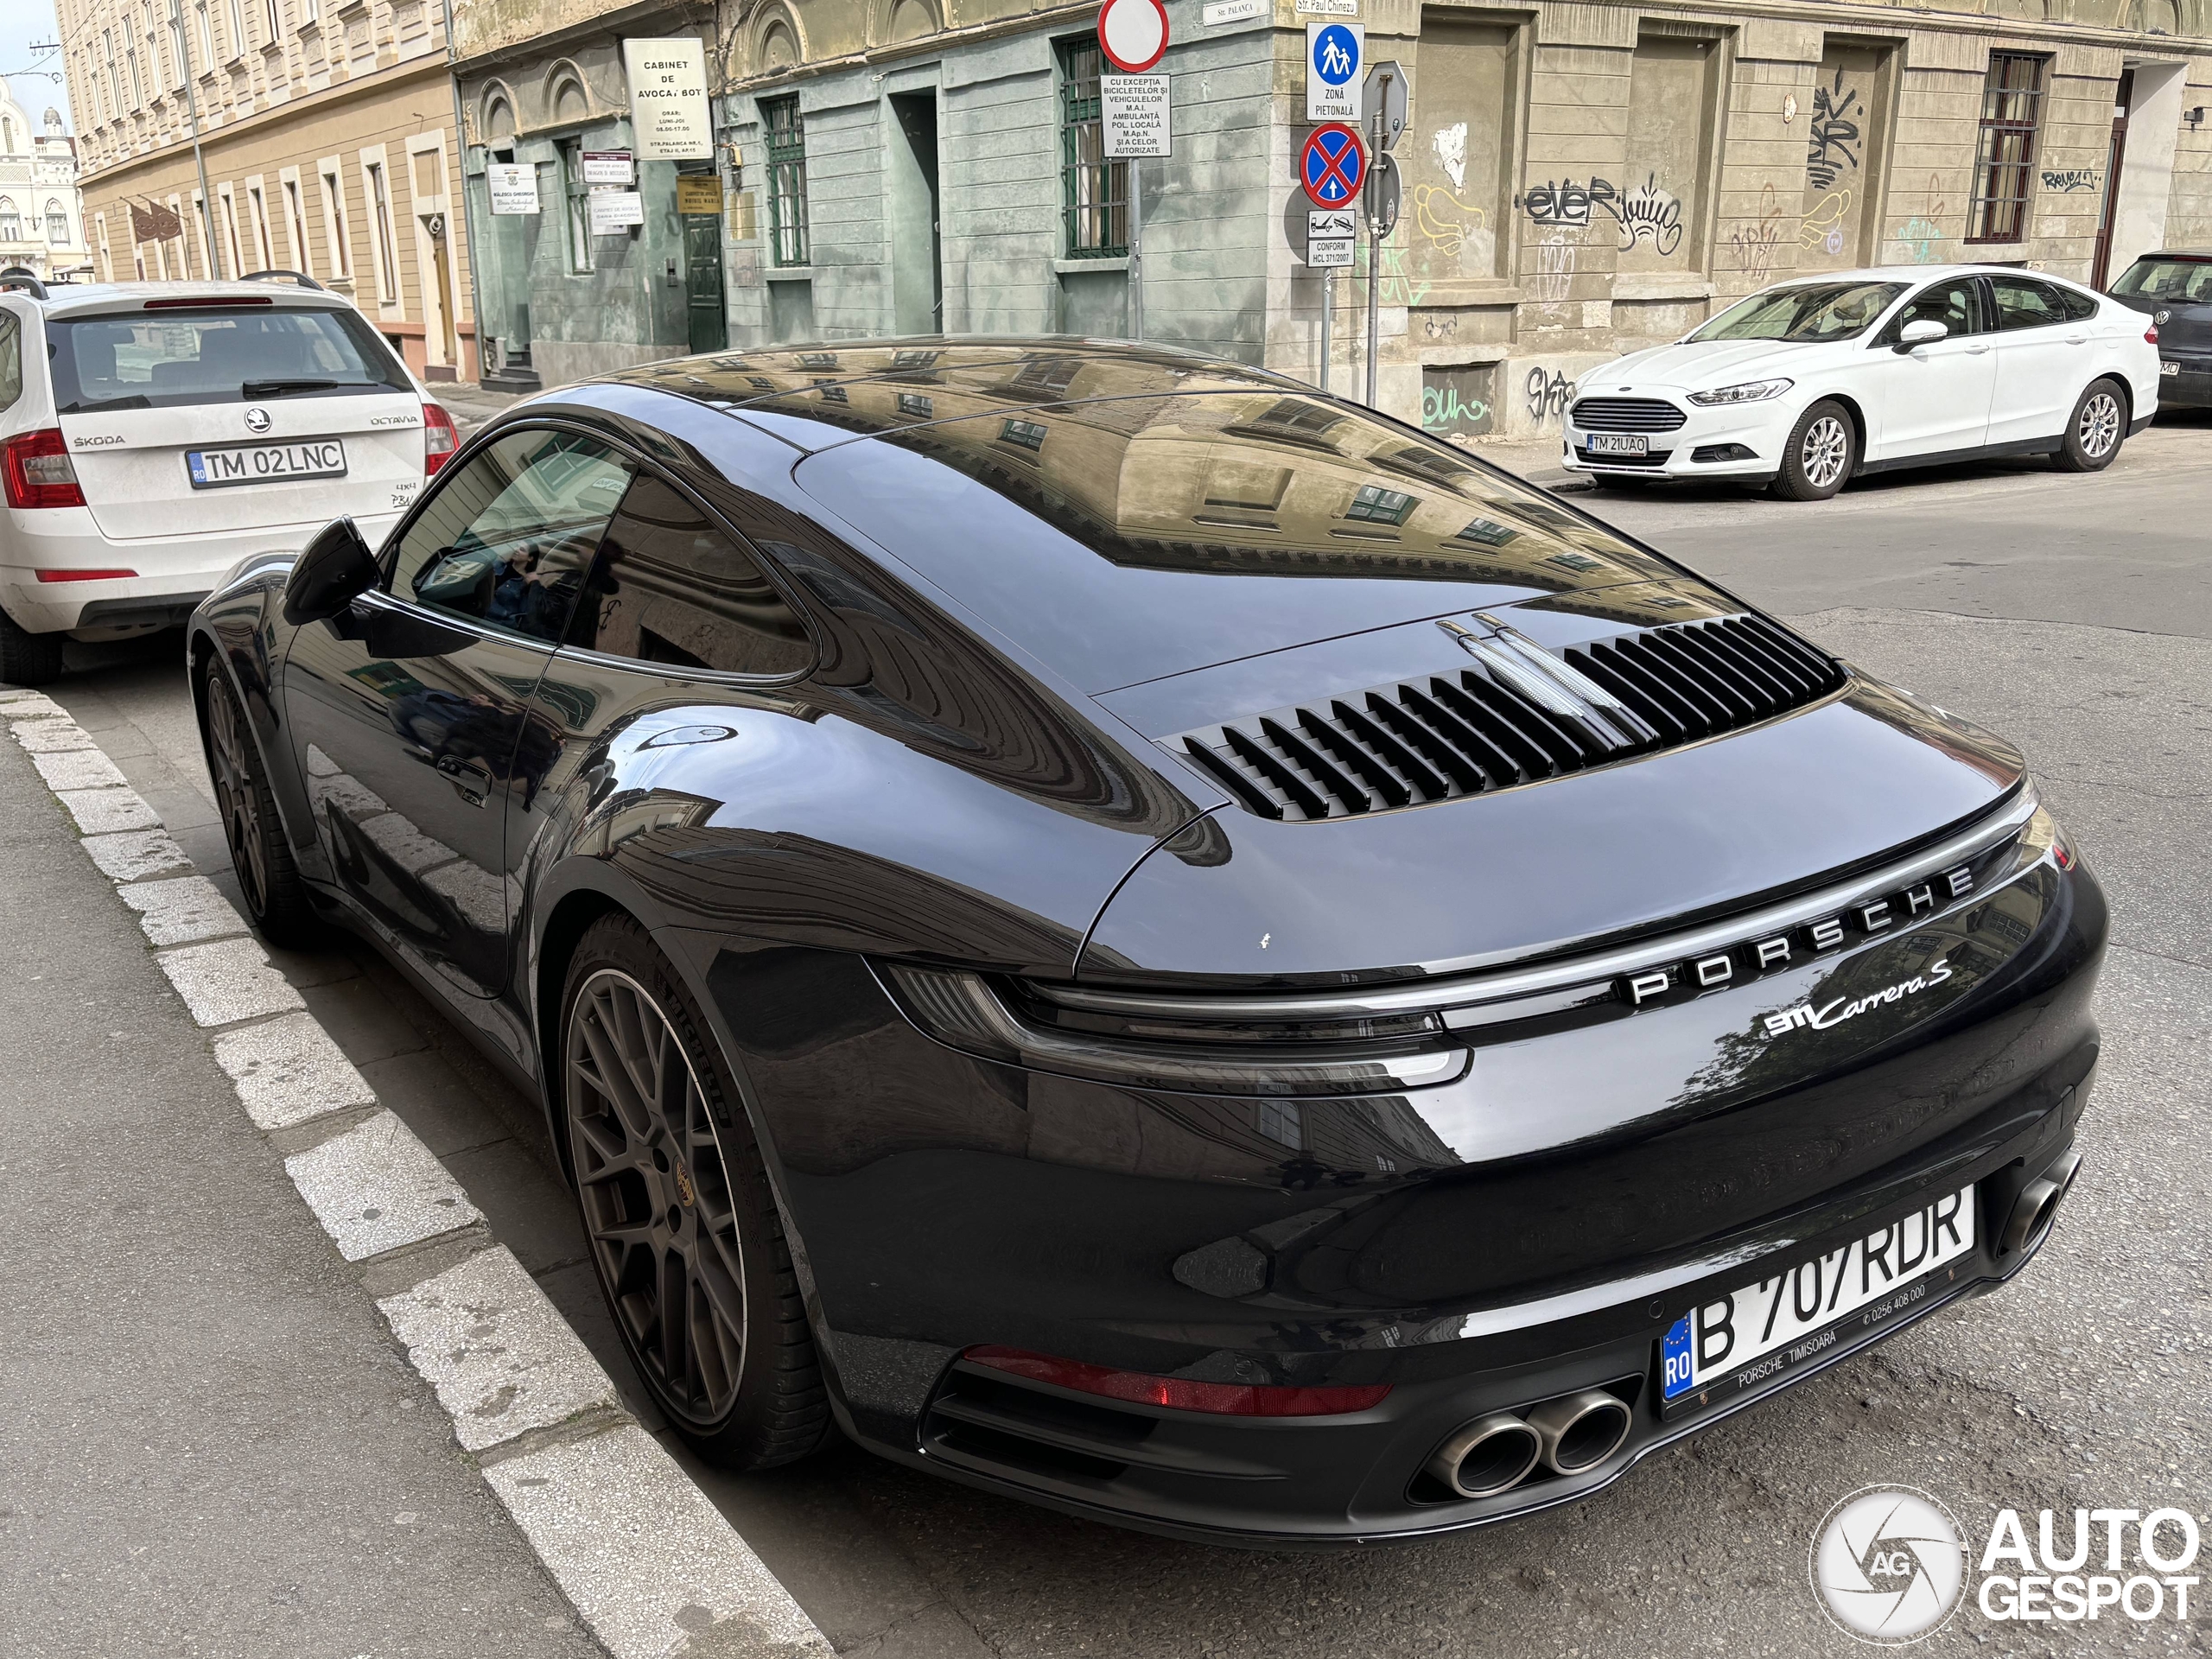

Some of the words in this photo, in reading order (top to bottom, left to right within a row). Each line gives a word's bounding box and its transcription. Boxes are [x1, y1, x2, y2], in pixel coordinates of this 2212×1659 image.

[1229, 3, 1253, 15] PALANCA
[1298, 0, 1309, 10] Str.
[1312, 0, 1325, 10] Paul
[1328, 0, 1354, 12] Chinezu
[644, 60, 689, 69] CABINET
[1325, 87, 1344, 99] ZONĂ
[1315, 104, 1354, 116] PIETONALĂ
[1317, 242, 1345, 251] CONFORM
[1313, 254, 1325, 263] HCL
[1326, 253, 1349, 263] 371/2007
[2160, 362, 2178, 373] MD
[371, 416, 418, 425] OCTAVIA
[73, 435, 126, 447] ŠKODA
[1593, 436, 1608, 450] TM
[1611, 437, 1645, 451] 21UAO
[205, 452, 247, 479] TM
[253, 444, 340, 474] 02LNC
[193, 469, 206, 480] RO
[1630, 867, 1974, 1005] PORSCHE
[1764, 1004, 1815, 1036] 911
[1812, 976, 1926, 1030] Carrera
[1929, 959, 1952, 987] S
[667, 992, 729, 1120] MICHELIN
[1697, 1293, 1735, 1373] B
[1738, 1355, 1783, 1388] PORSCHE
[1789, 1331, 1836, 1363] TIMISOARA
[1872, 1301, 1892, 1321] 0256
[1894, 1292, 1909, 1309] 408
[1910, 1284, 1925, 1301] 000
[1666, 1351, 1690, 1387] RO
